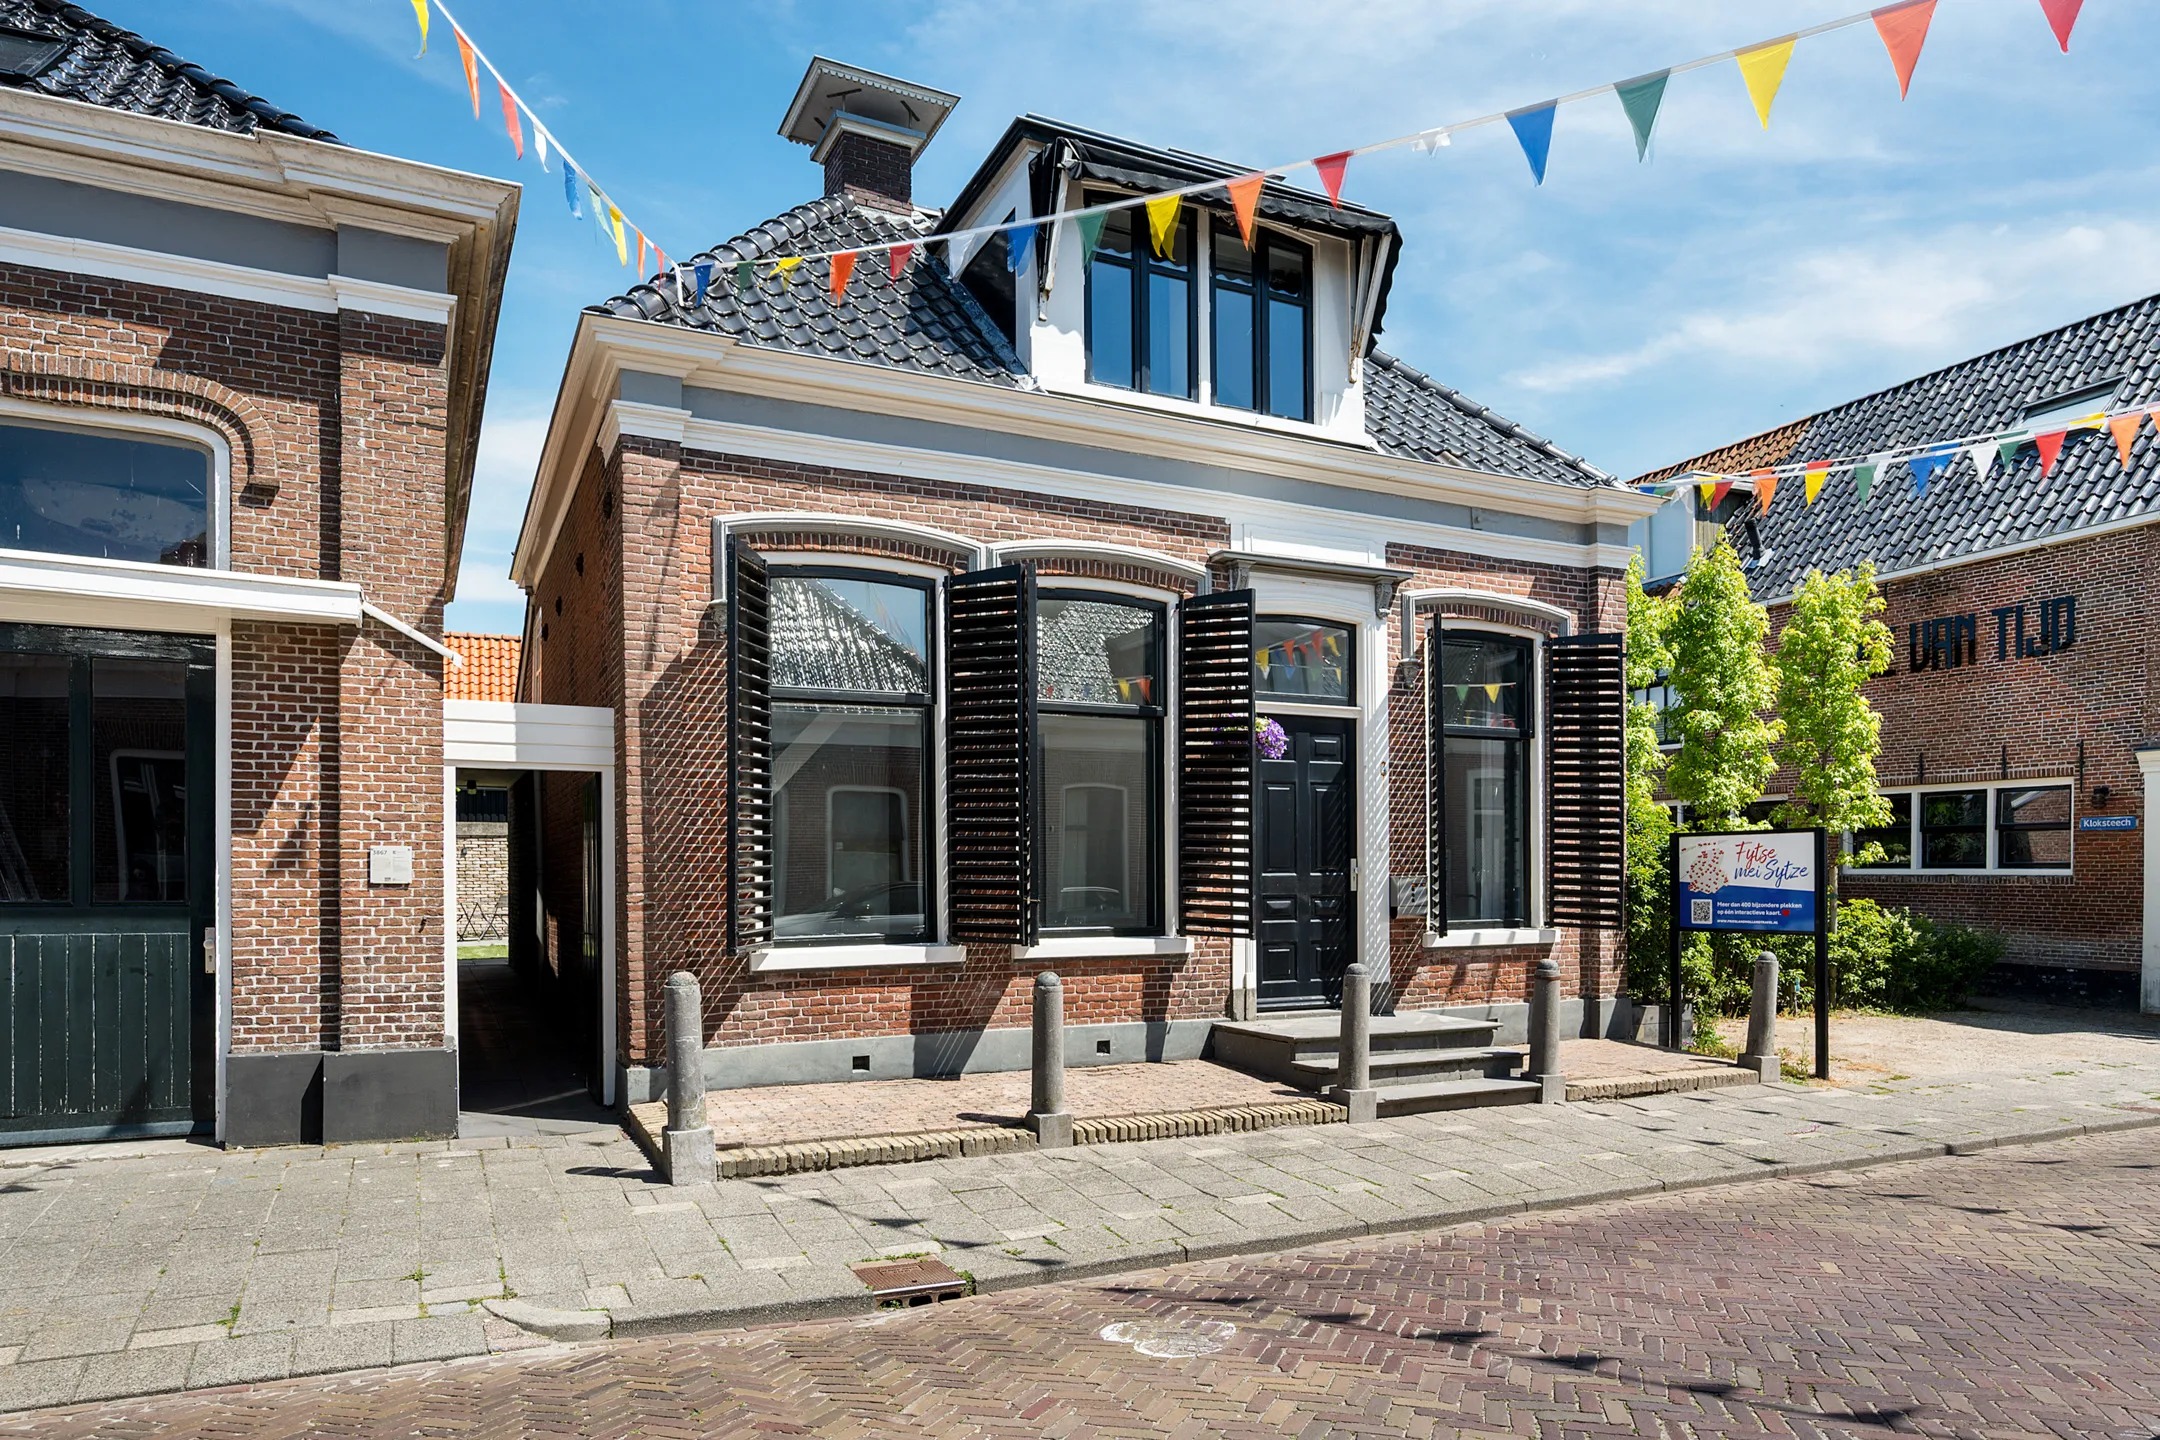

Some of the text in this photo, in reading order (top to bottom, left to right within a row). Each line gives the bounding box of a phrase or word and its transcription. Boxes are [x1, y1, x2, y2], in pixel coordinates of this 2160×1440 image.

[1909, 612, 1976, 674] VAN
[1991, 594, 2075, 661] TIJD
[2083, 818, 2131, 828] Kloksteech
[1735, 841, 1778, 869] Fytse
[1734, 858, 1809, 888] mei Sytze
